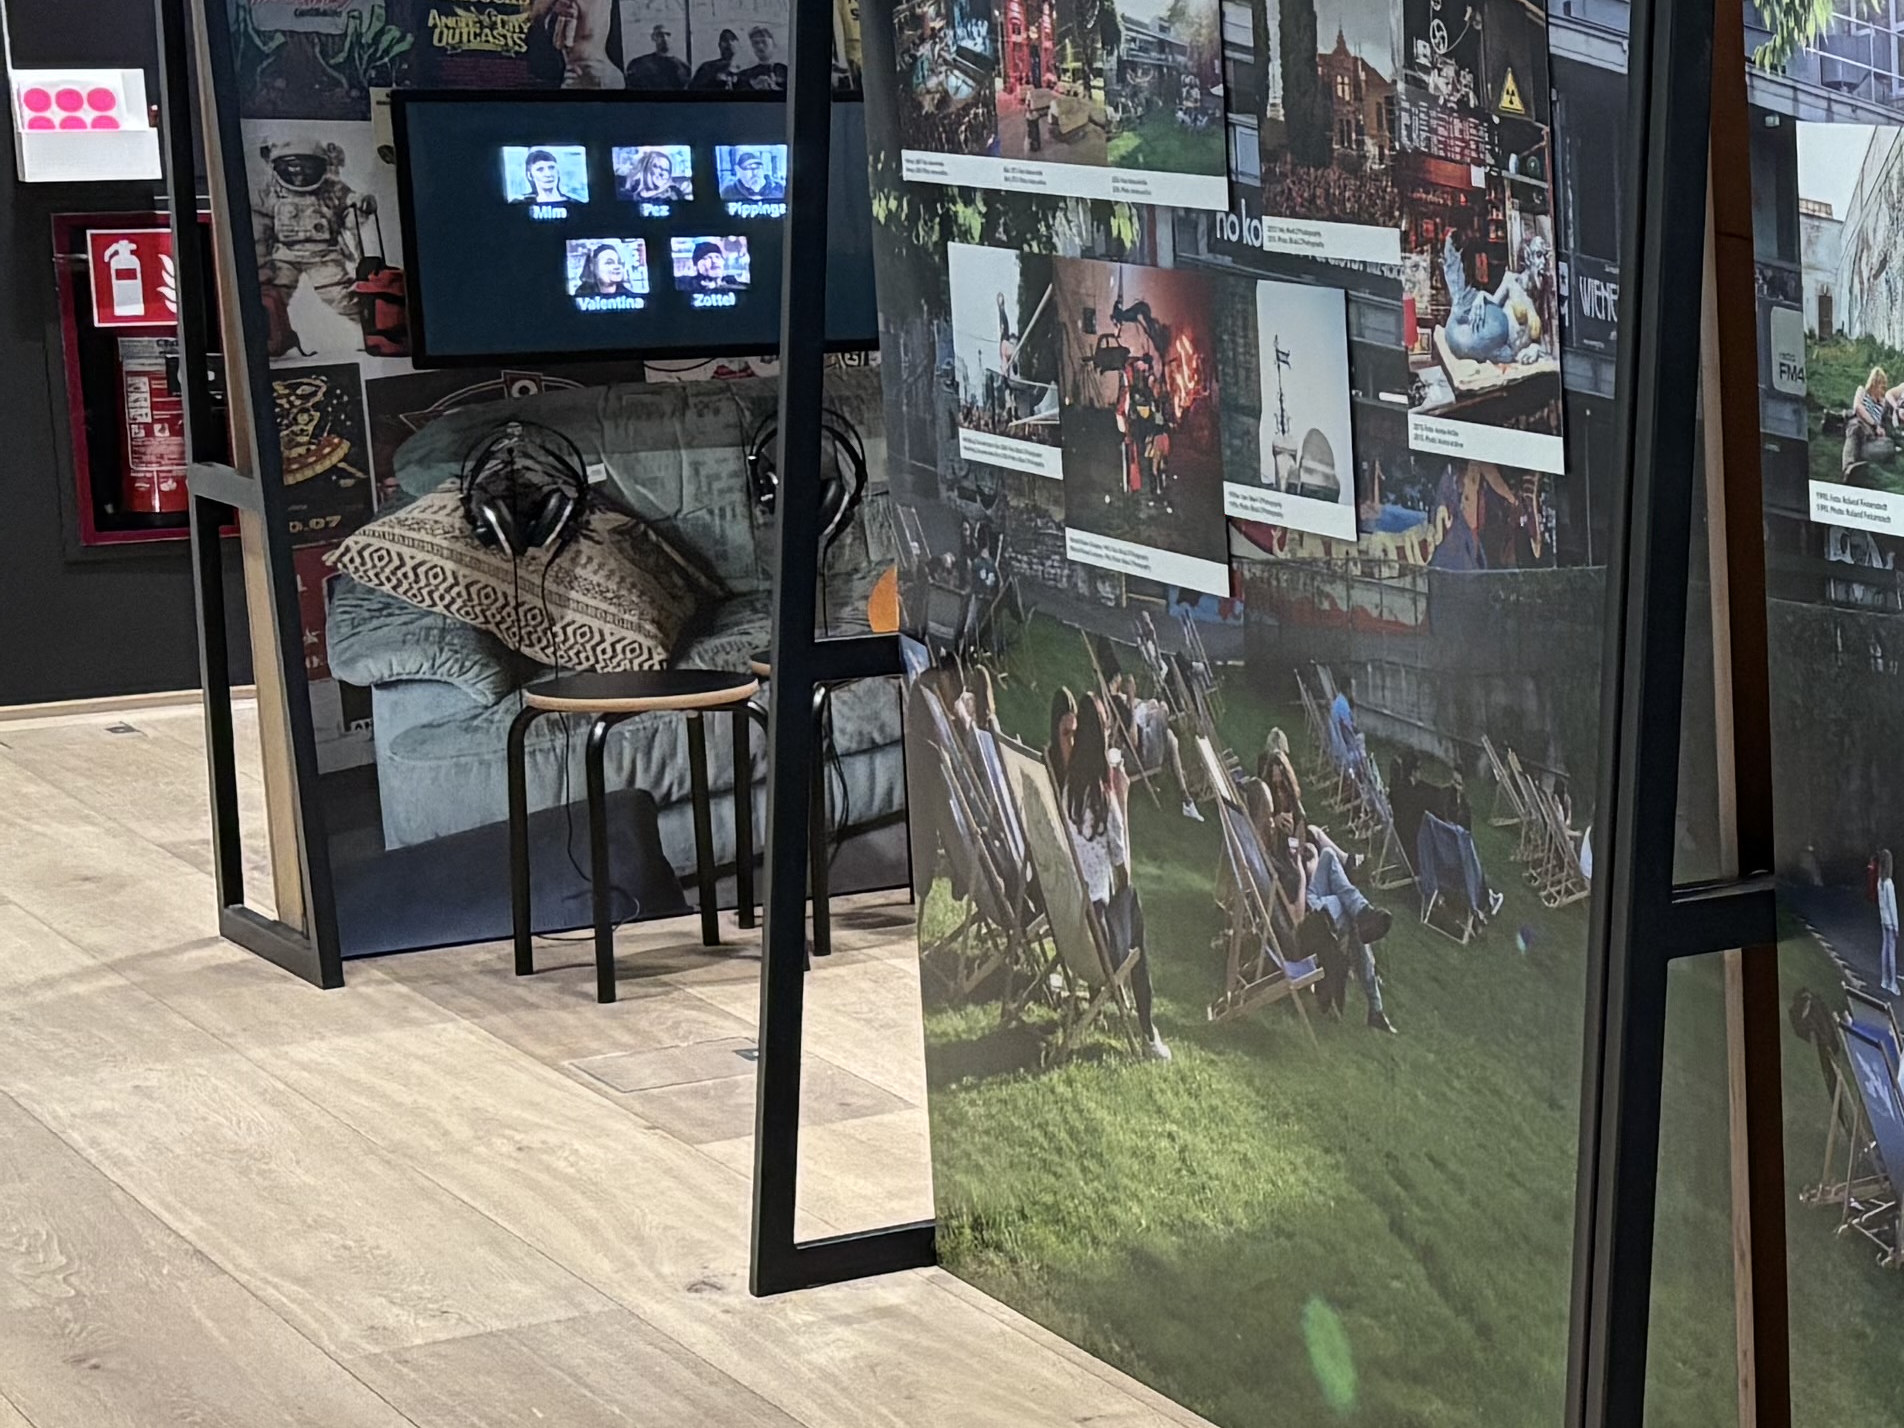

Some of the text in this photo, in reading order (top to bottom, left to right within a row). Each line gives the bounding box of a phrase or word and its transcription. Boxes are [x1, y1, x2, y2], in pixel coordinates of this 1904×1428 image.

[432, 27, 529, 53] OUTCASTS
[530, 204, 567, 219] Mim
[576, 292, 736, 311] Valentina Zottel
